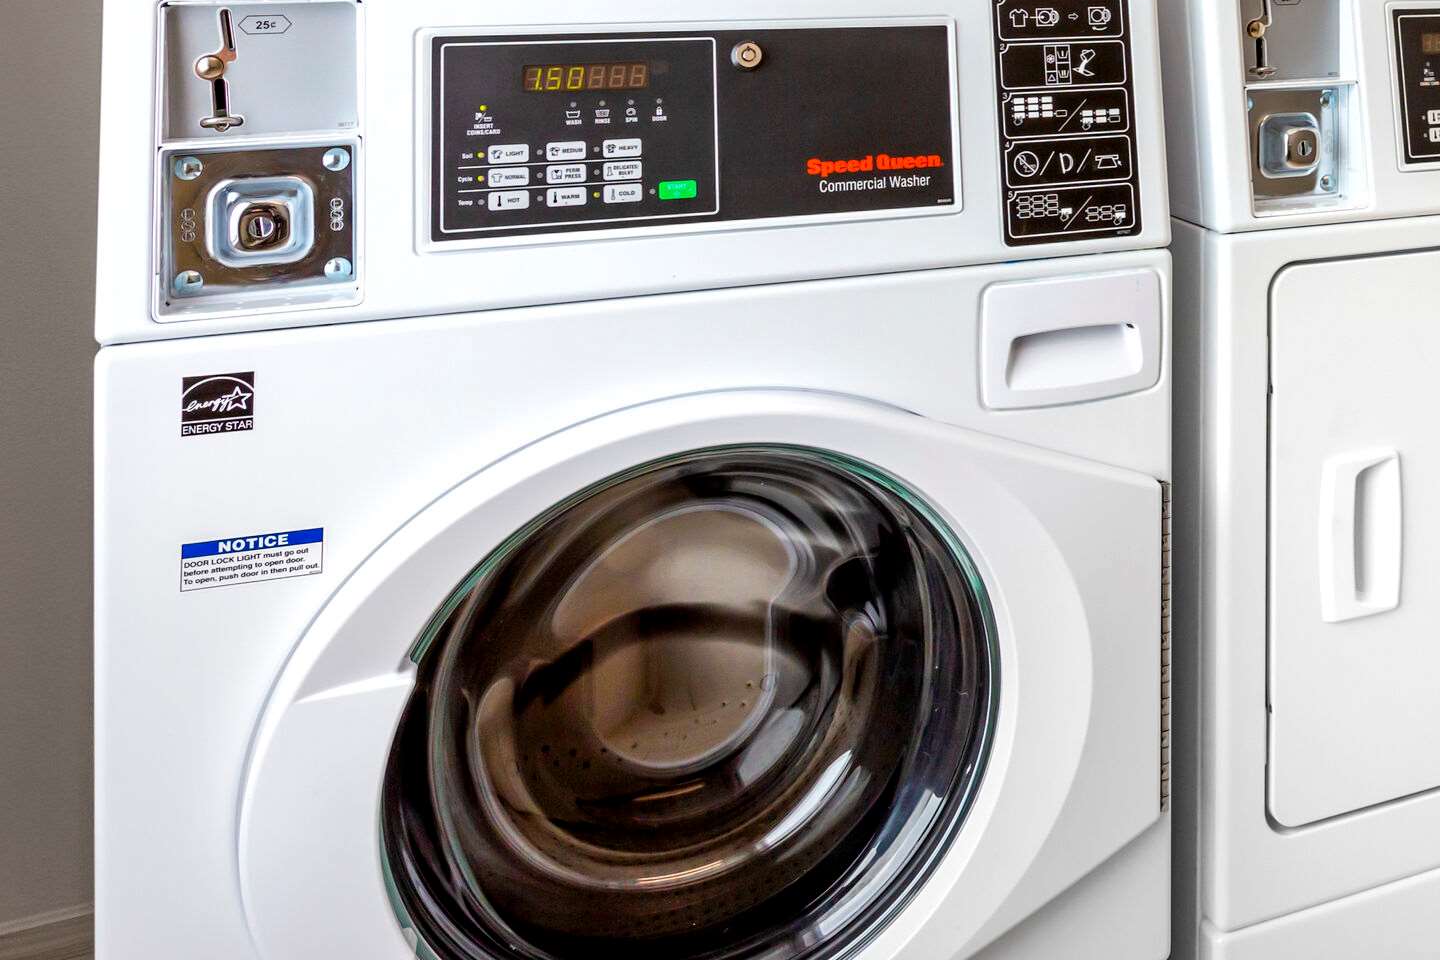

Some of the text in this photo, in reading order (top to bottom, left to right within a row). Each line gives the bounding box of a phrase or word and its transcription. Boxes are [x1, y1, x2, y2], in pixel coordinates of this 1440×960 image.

[807, 153, 942, 178] Speed Queen
[820, 175, 931, 193] Commercial Washer
[183, 420, 252, 435] ENERGY STAR
[218, 534, 288, 553] NOTICE
[184, 569, 208, 577] before
[211, 563, 252, 573] attempting
[265, 560, 284, 568] open
[219, 574, 239, 582] push
